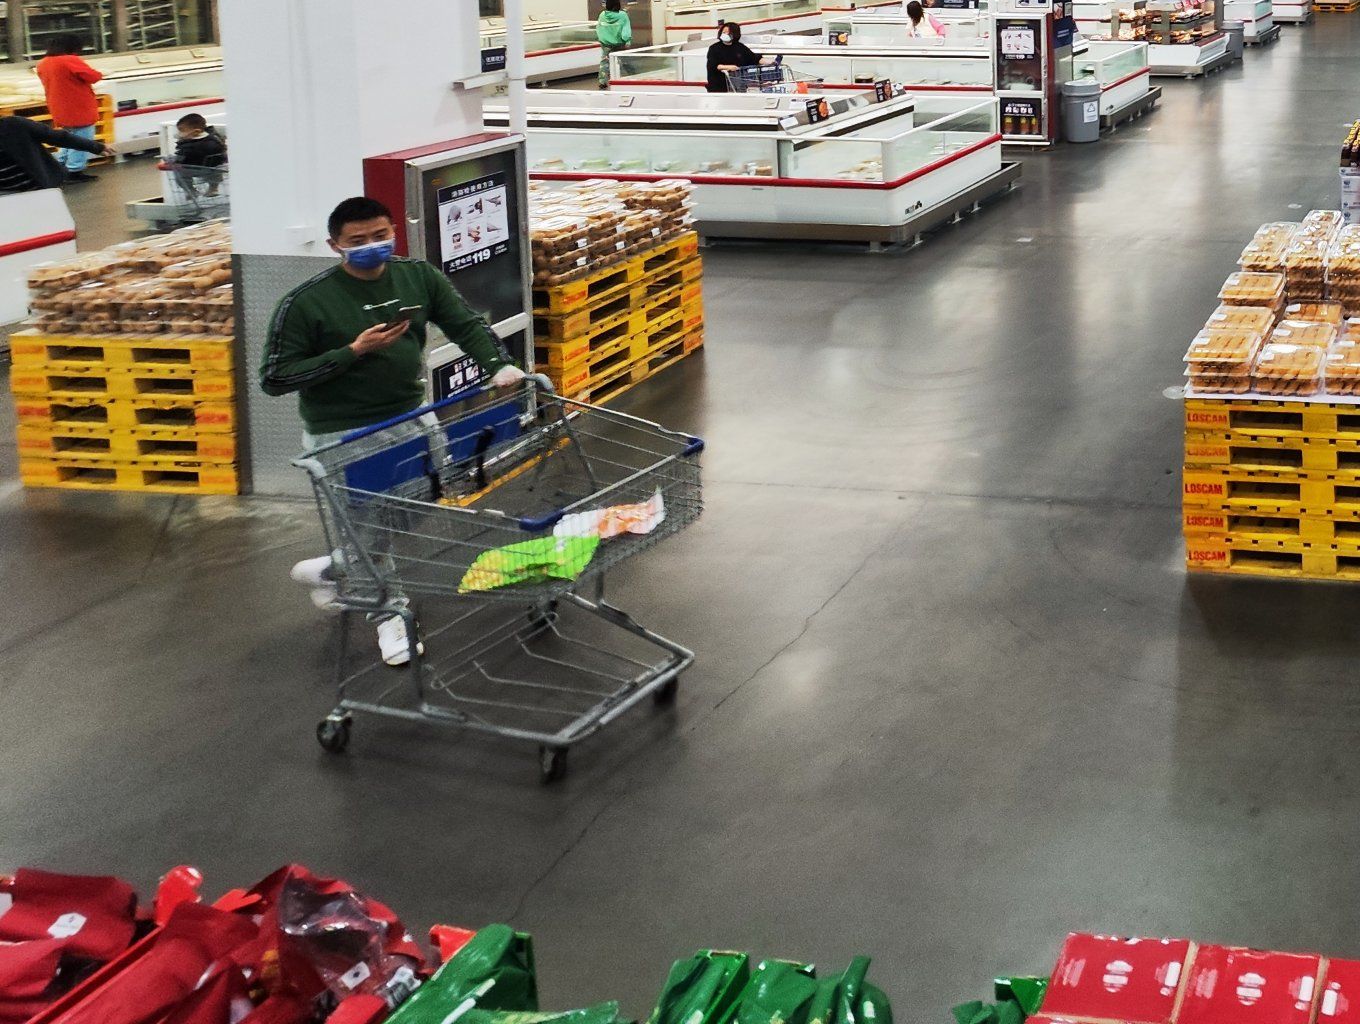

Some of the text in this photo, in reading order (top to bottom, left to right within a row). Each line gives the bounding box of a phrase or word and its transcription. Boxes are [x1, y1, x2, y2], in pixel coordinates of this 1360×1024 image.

[472, 247, 491, 264] 119
[1187, 412, 1228, 424] LOSCAM
[1184, 482, 1223, 496] LOSCAM
[1186, 514, 1225, 529] LOSCAM
[1188, 549, 1226, 562] LOSCAM
